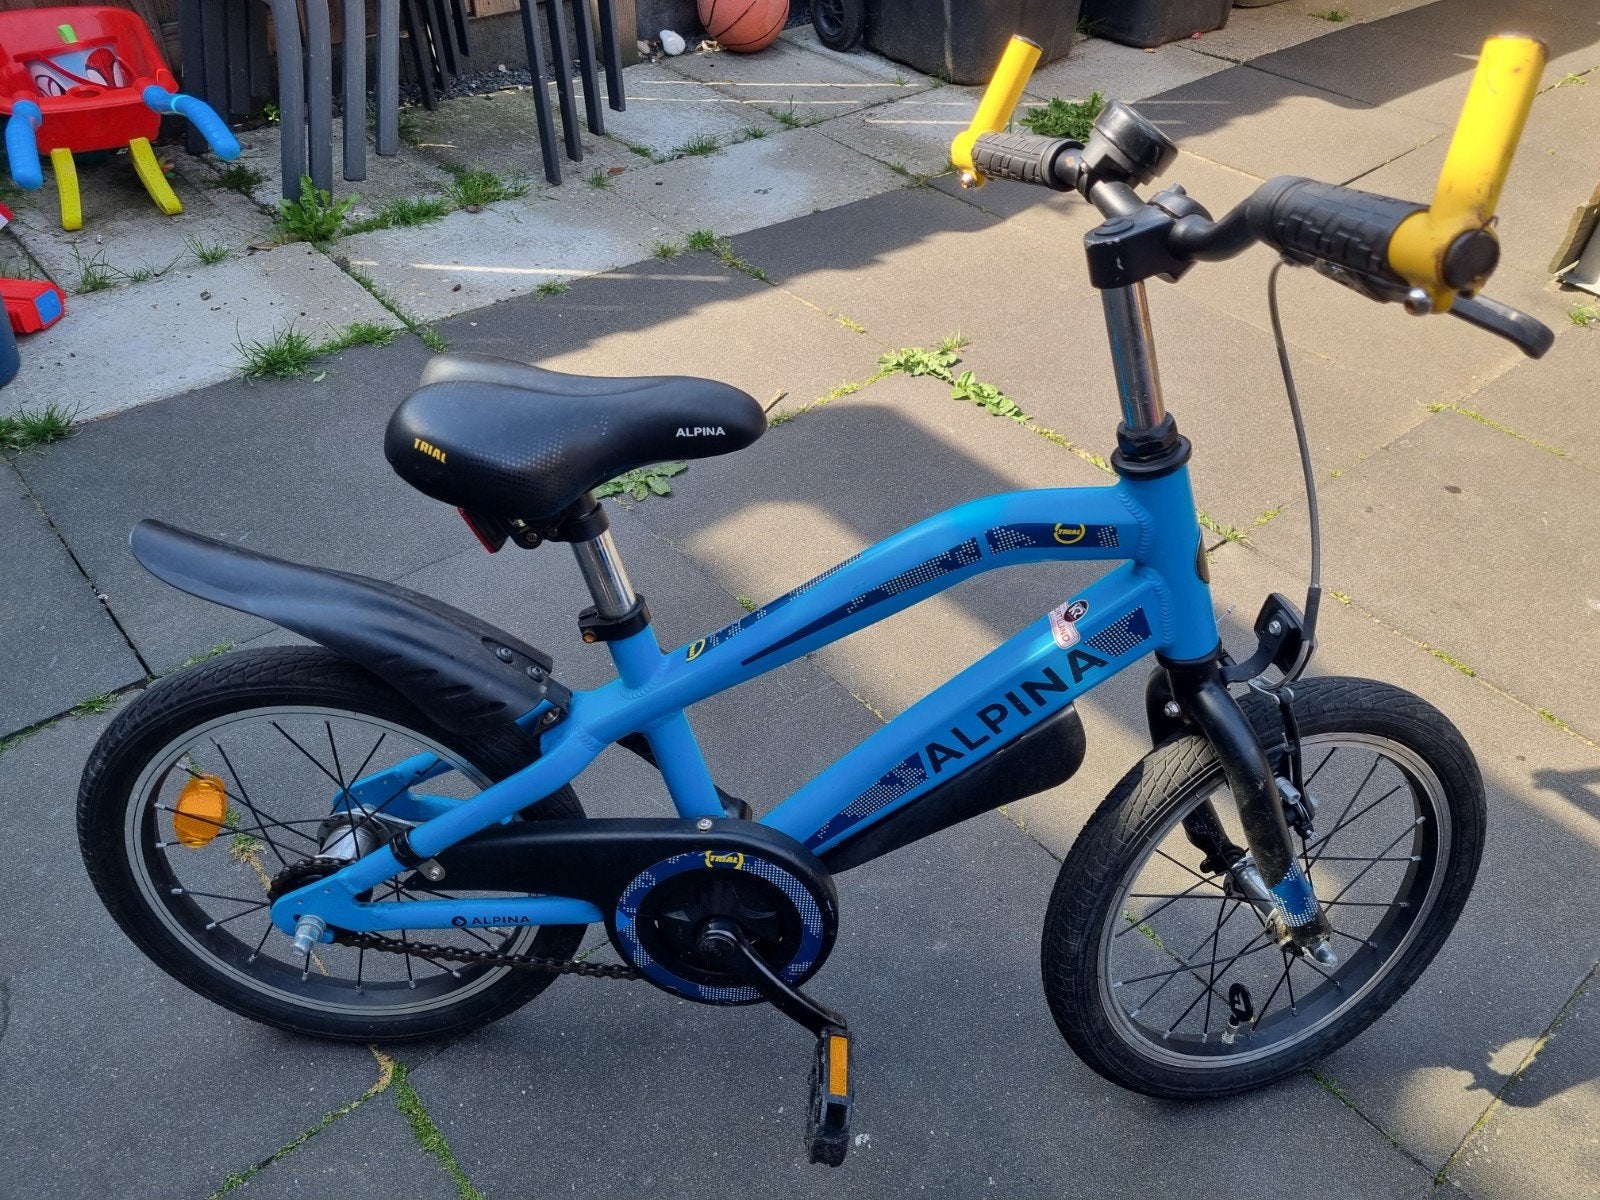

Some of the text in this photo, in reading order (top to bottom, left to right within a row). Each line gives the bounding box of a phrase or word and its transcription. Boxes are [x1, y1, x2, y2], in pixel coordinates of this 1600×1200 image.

[675, 426, 726, 437] ALPINA
[414, 437, 446, 464] TRIAL
[924, 648, 1109, 774] ALPINA
[709, 855, 738, 864] TRIAL
[472, 915, 531, 925] ALPINA
